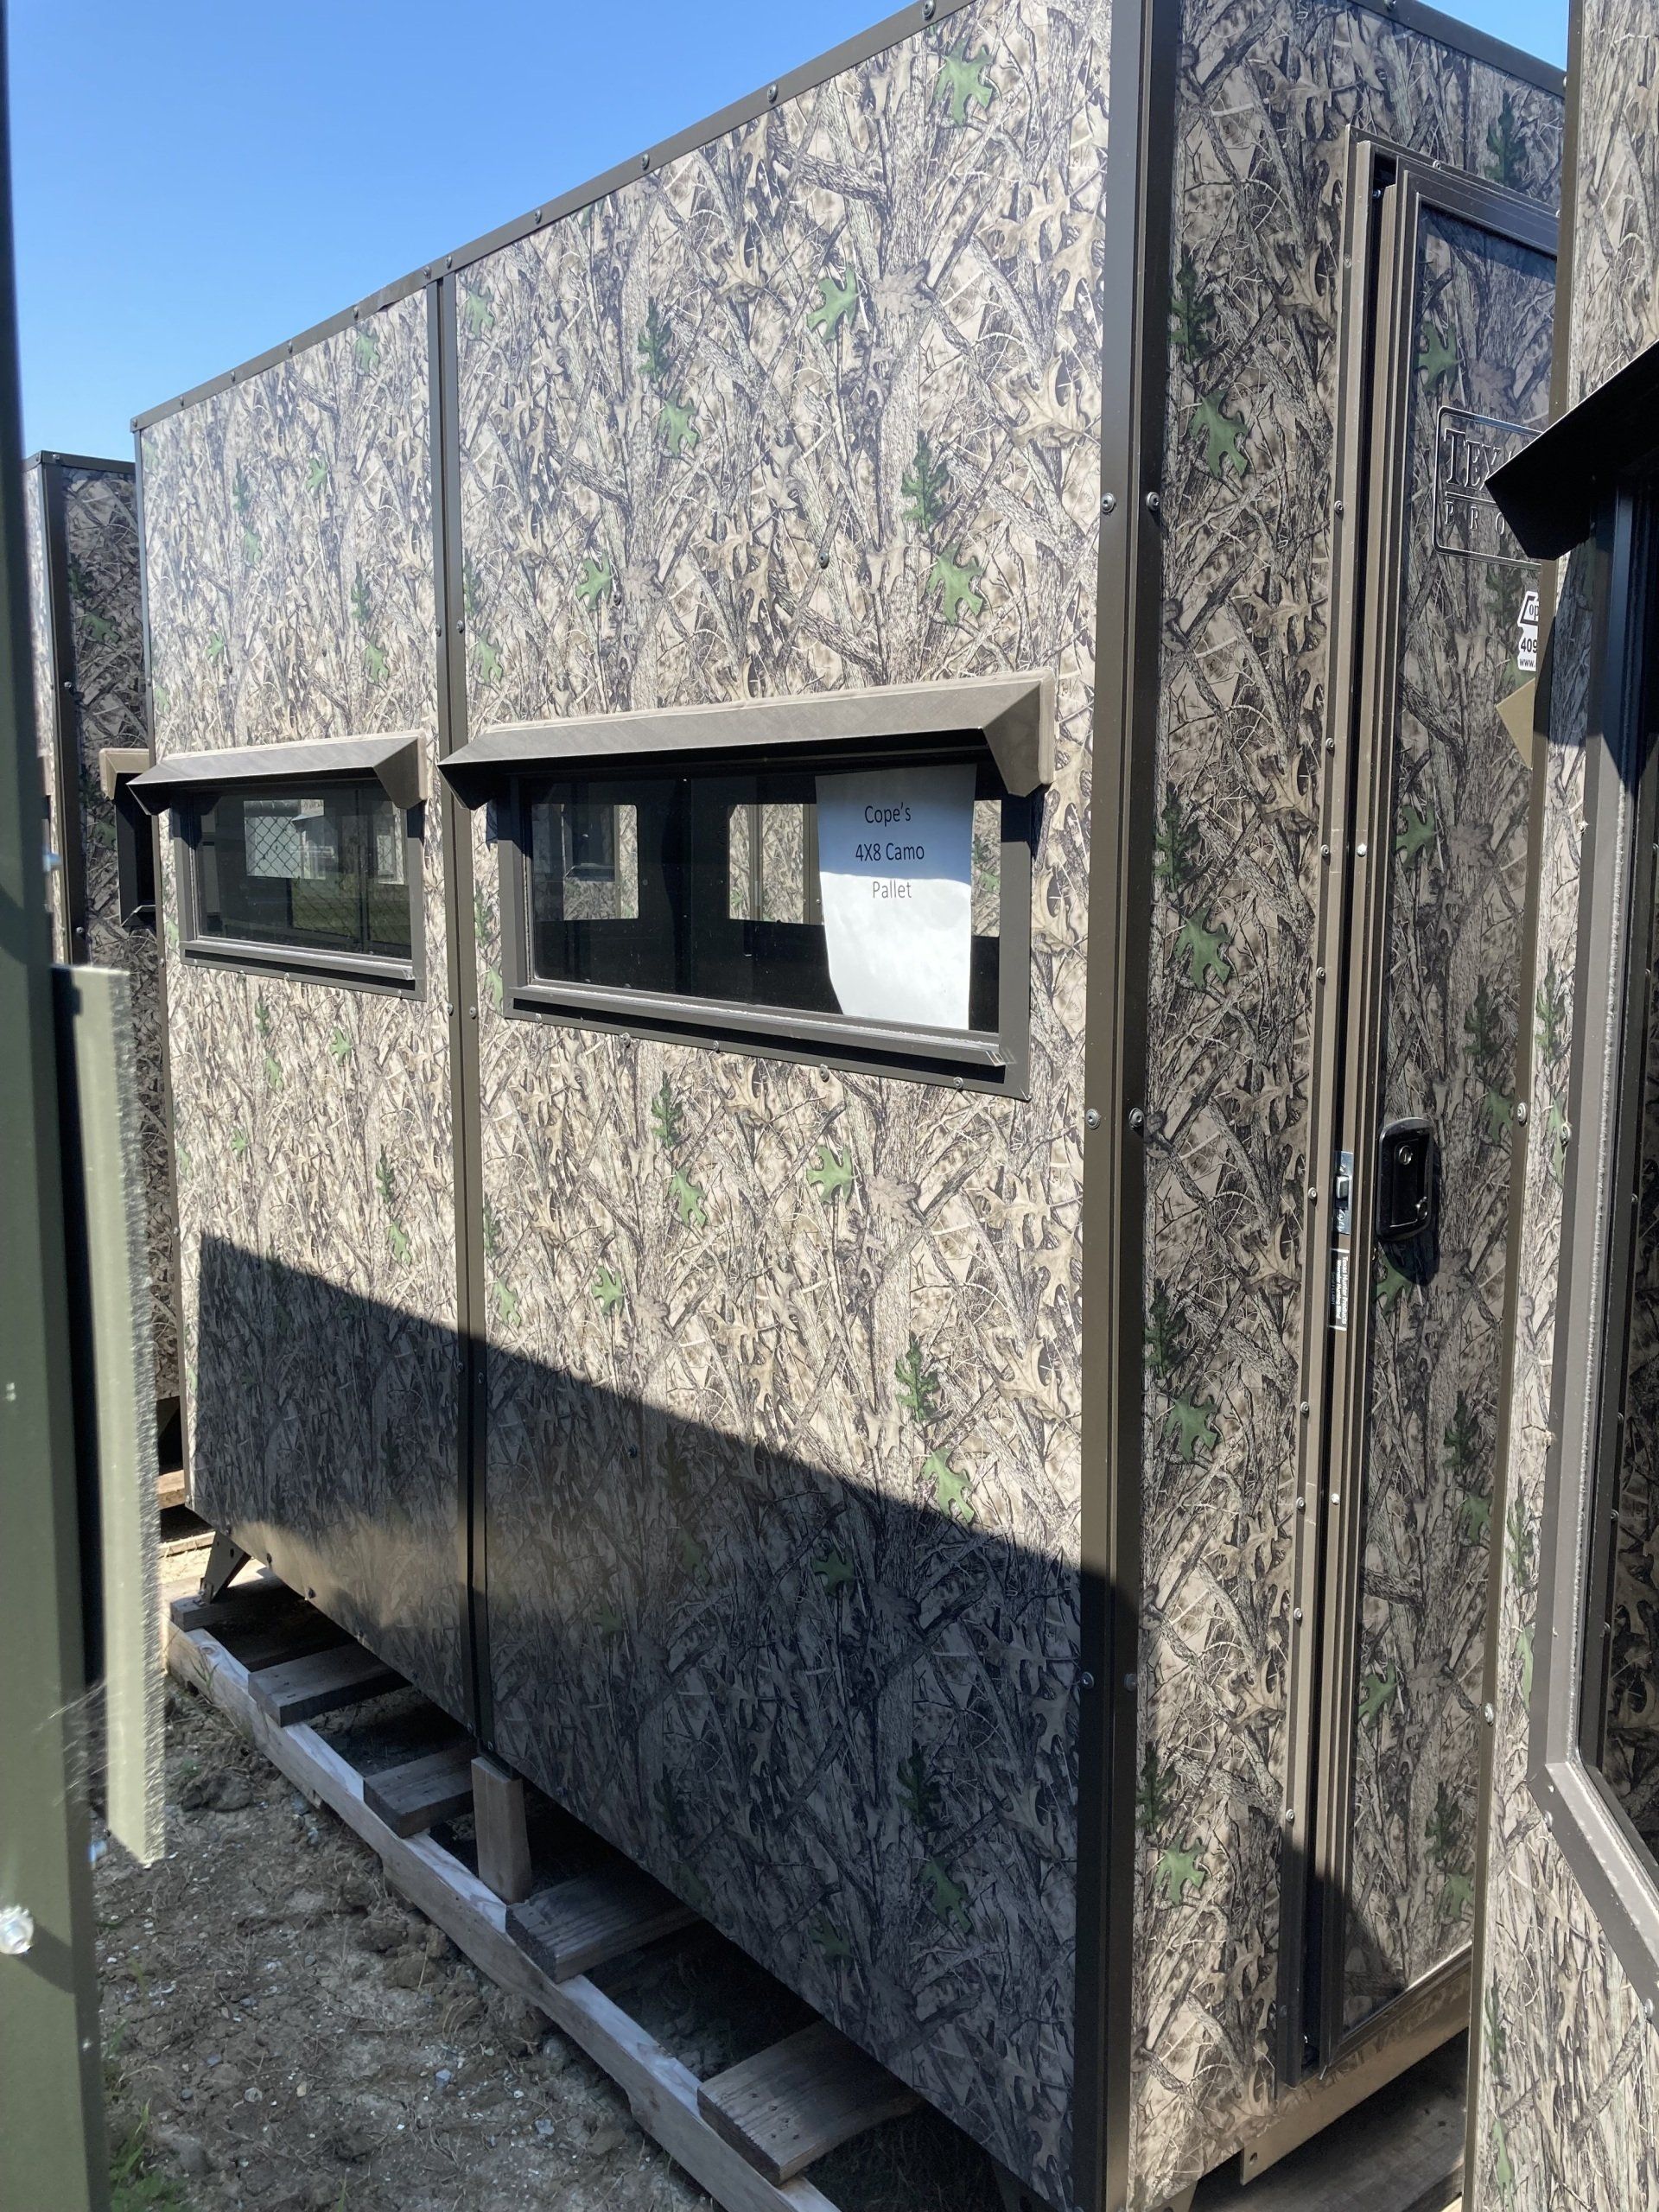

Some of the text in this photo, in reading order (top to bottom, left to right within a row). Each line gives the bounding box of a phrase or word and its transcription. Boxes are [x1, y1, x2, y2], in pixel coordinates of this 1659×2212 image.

[864, 802, 912, 827] Cope's
[855, 842, 925, 861] 4X8 Camo
[872, 880, 912, 899] Pallet
